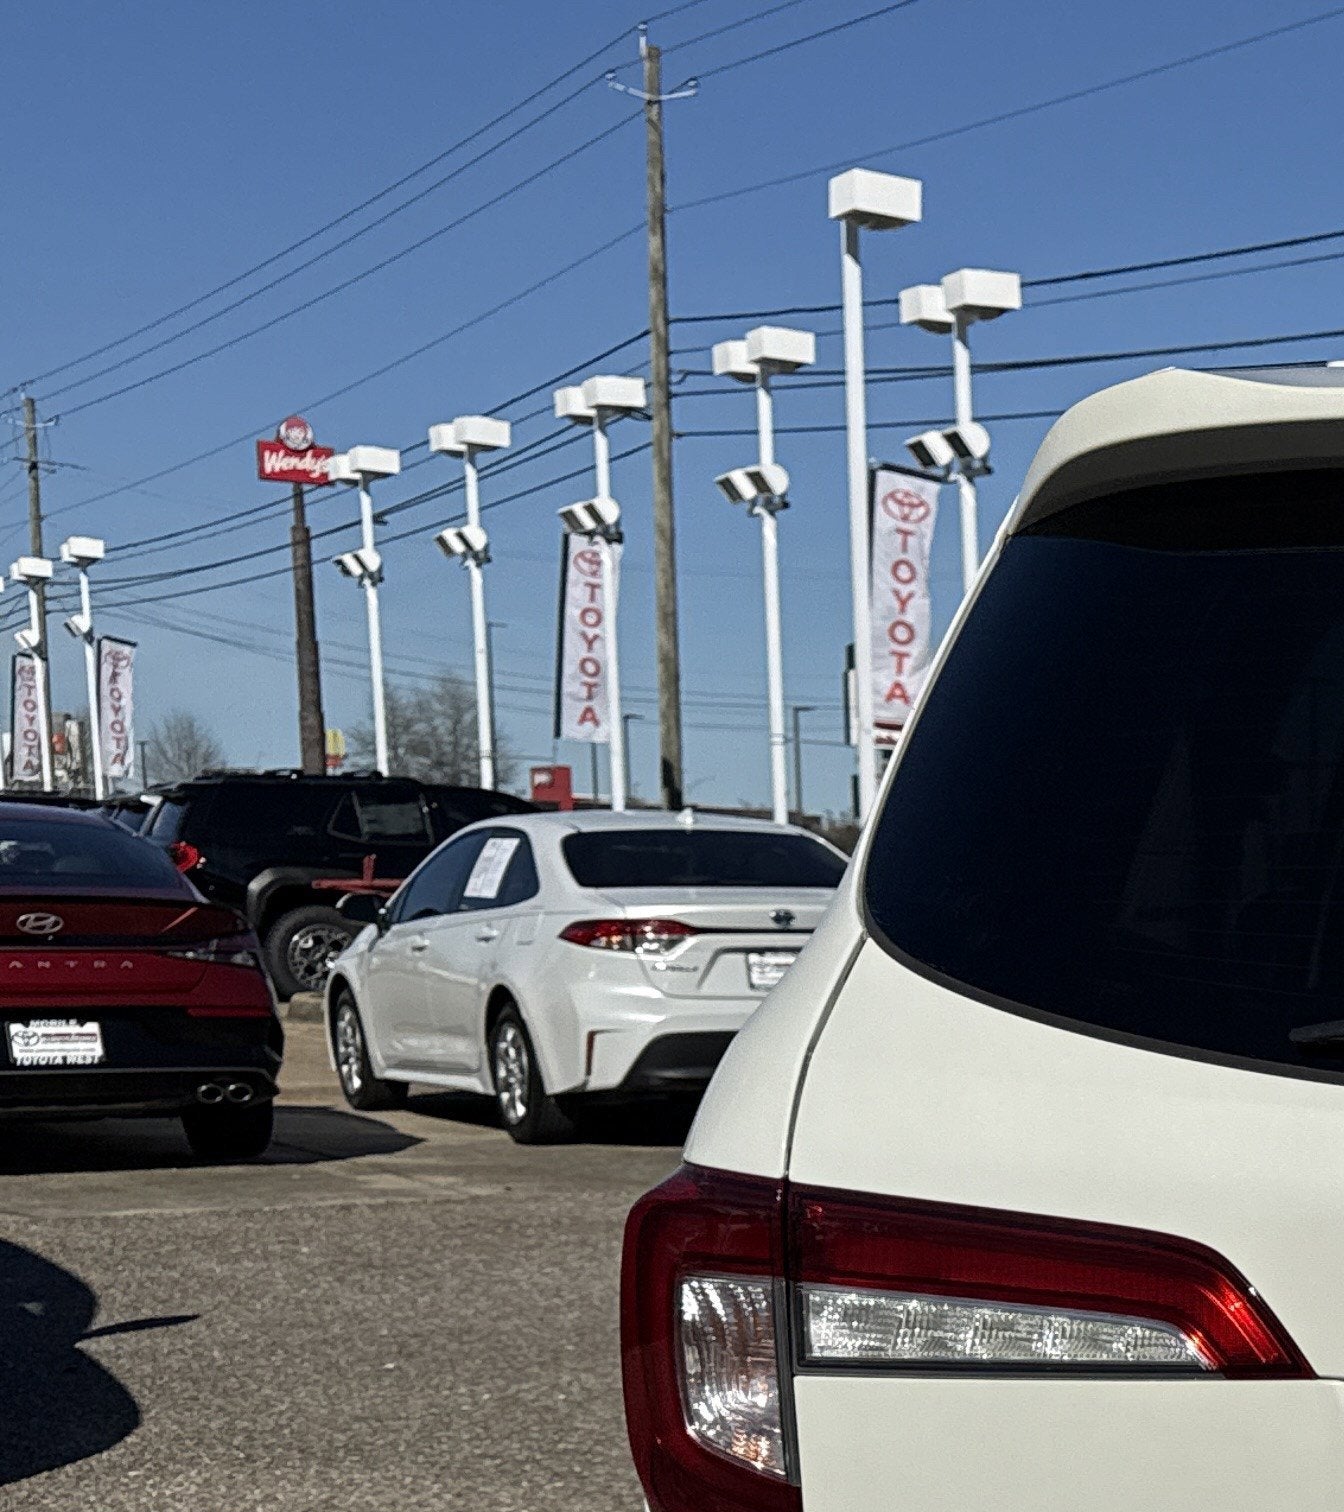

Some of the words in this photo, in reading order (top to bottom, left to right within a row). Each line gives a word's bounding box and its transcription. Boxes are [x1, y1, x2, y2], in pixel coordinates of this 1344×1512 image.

[578, 582, 603, 727] TOYOTA
[885, 527, 917, 706] TOYOTA
[22, 684, 38, 771] TOYOTA
[109, 670, 125, 766] TOYOTA
